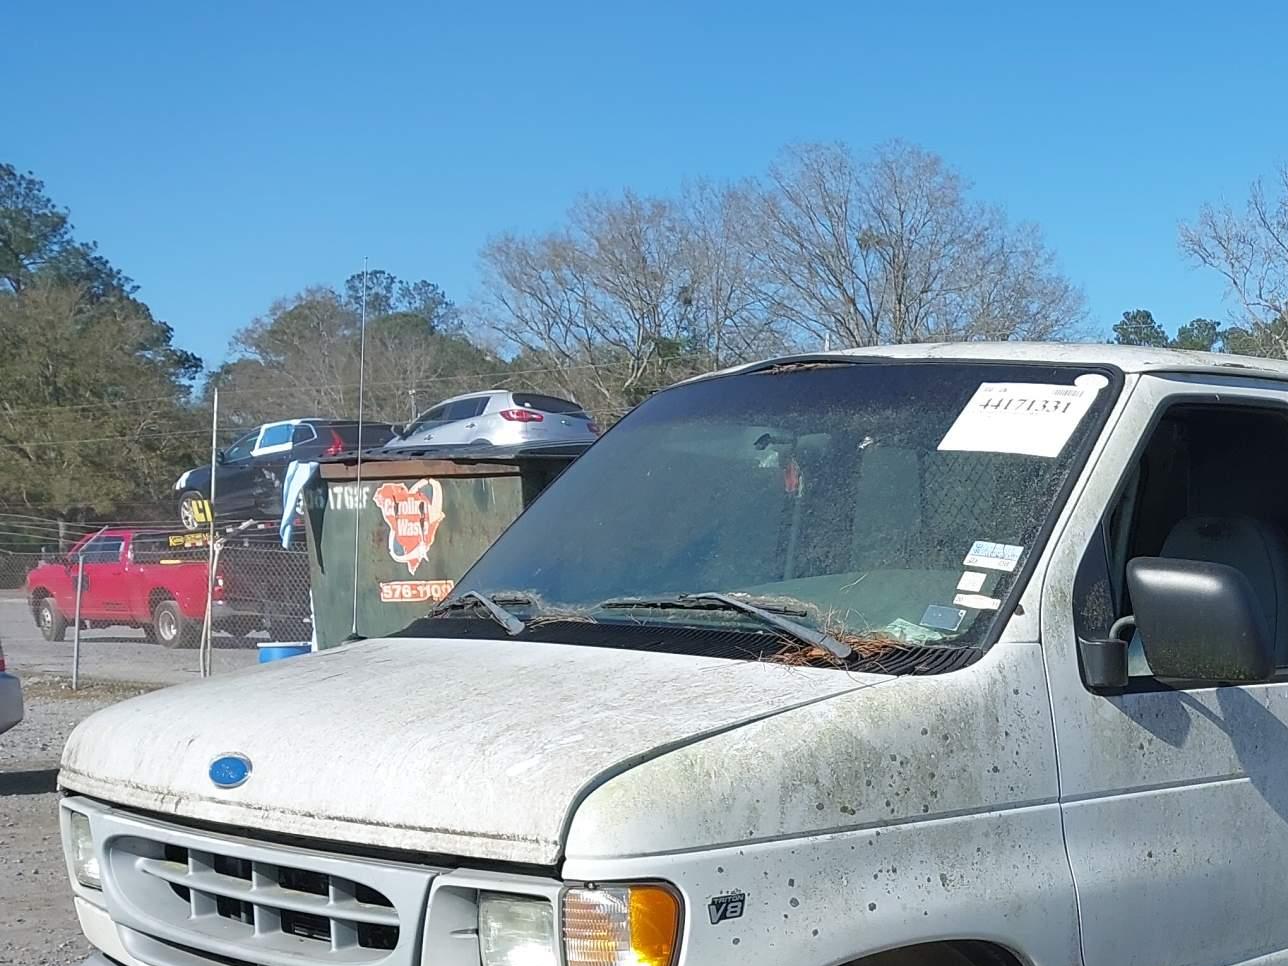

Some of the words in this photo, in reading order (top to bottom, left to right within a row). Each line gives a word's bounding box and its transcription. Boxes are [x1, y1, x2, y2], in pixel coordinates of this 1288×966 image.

[978, 397, 1072, 413] 44171331
[397, 518, 429, 537] Waste
[709, 901, 743, 923] V8
